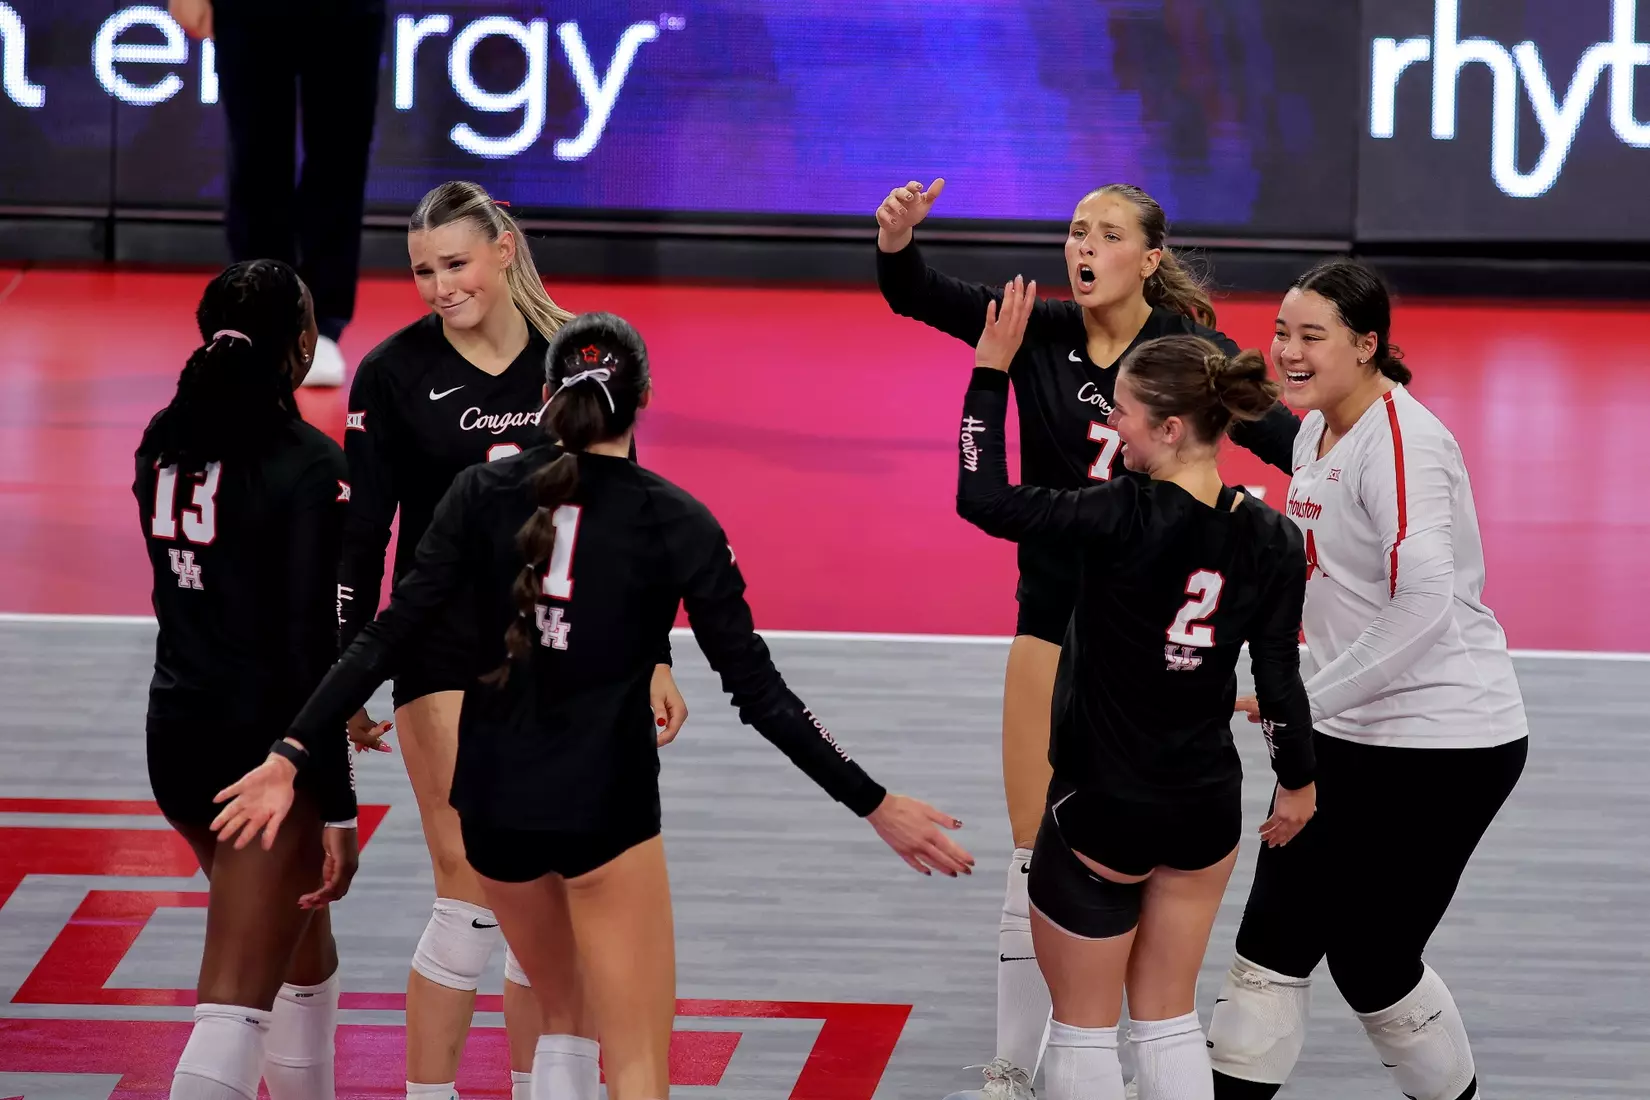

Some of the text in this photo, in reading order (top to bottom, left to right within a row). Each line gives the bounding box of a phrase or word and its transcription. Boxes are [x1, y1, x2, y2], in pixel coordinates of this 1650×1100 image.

[92, 4, 660, 160] ergy
[1077, 381, 1116, 416] Coug
[1087, 420, 1122, 482] 7
[152, 453, 222, 546] 13
[168, 548, 204, 590] UH
[542, 503, 582, 601] 1
[534, 603, 572, 650] UH
[1165, 568, 1226, 648] 2
